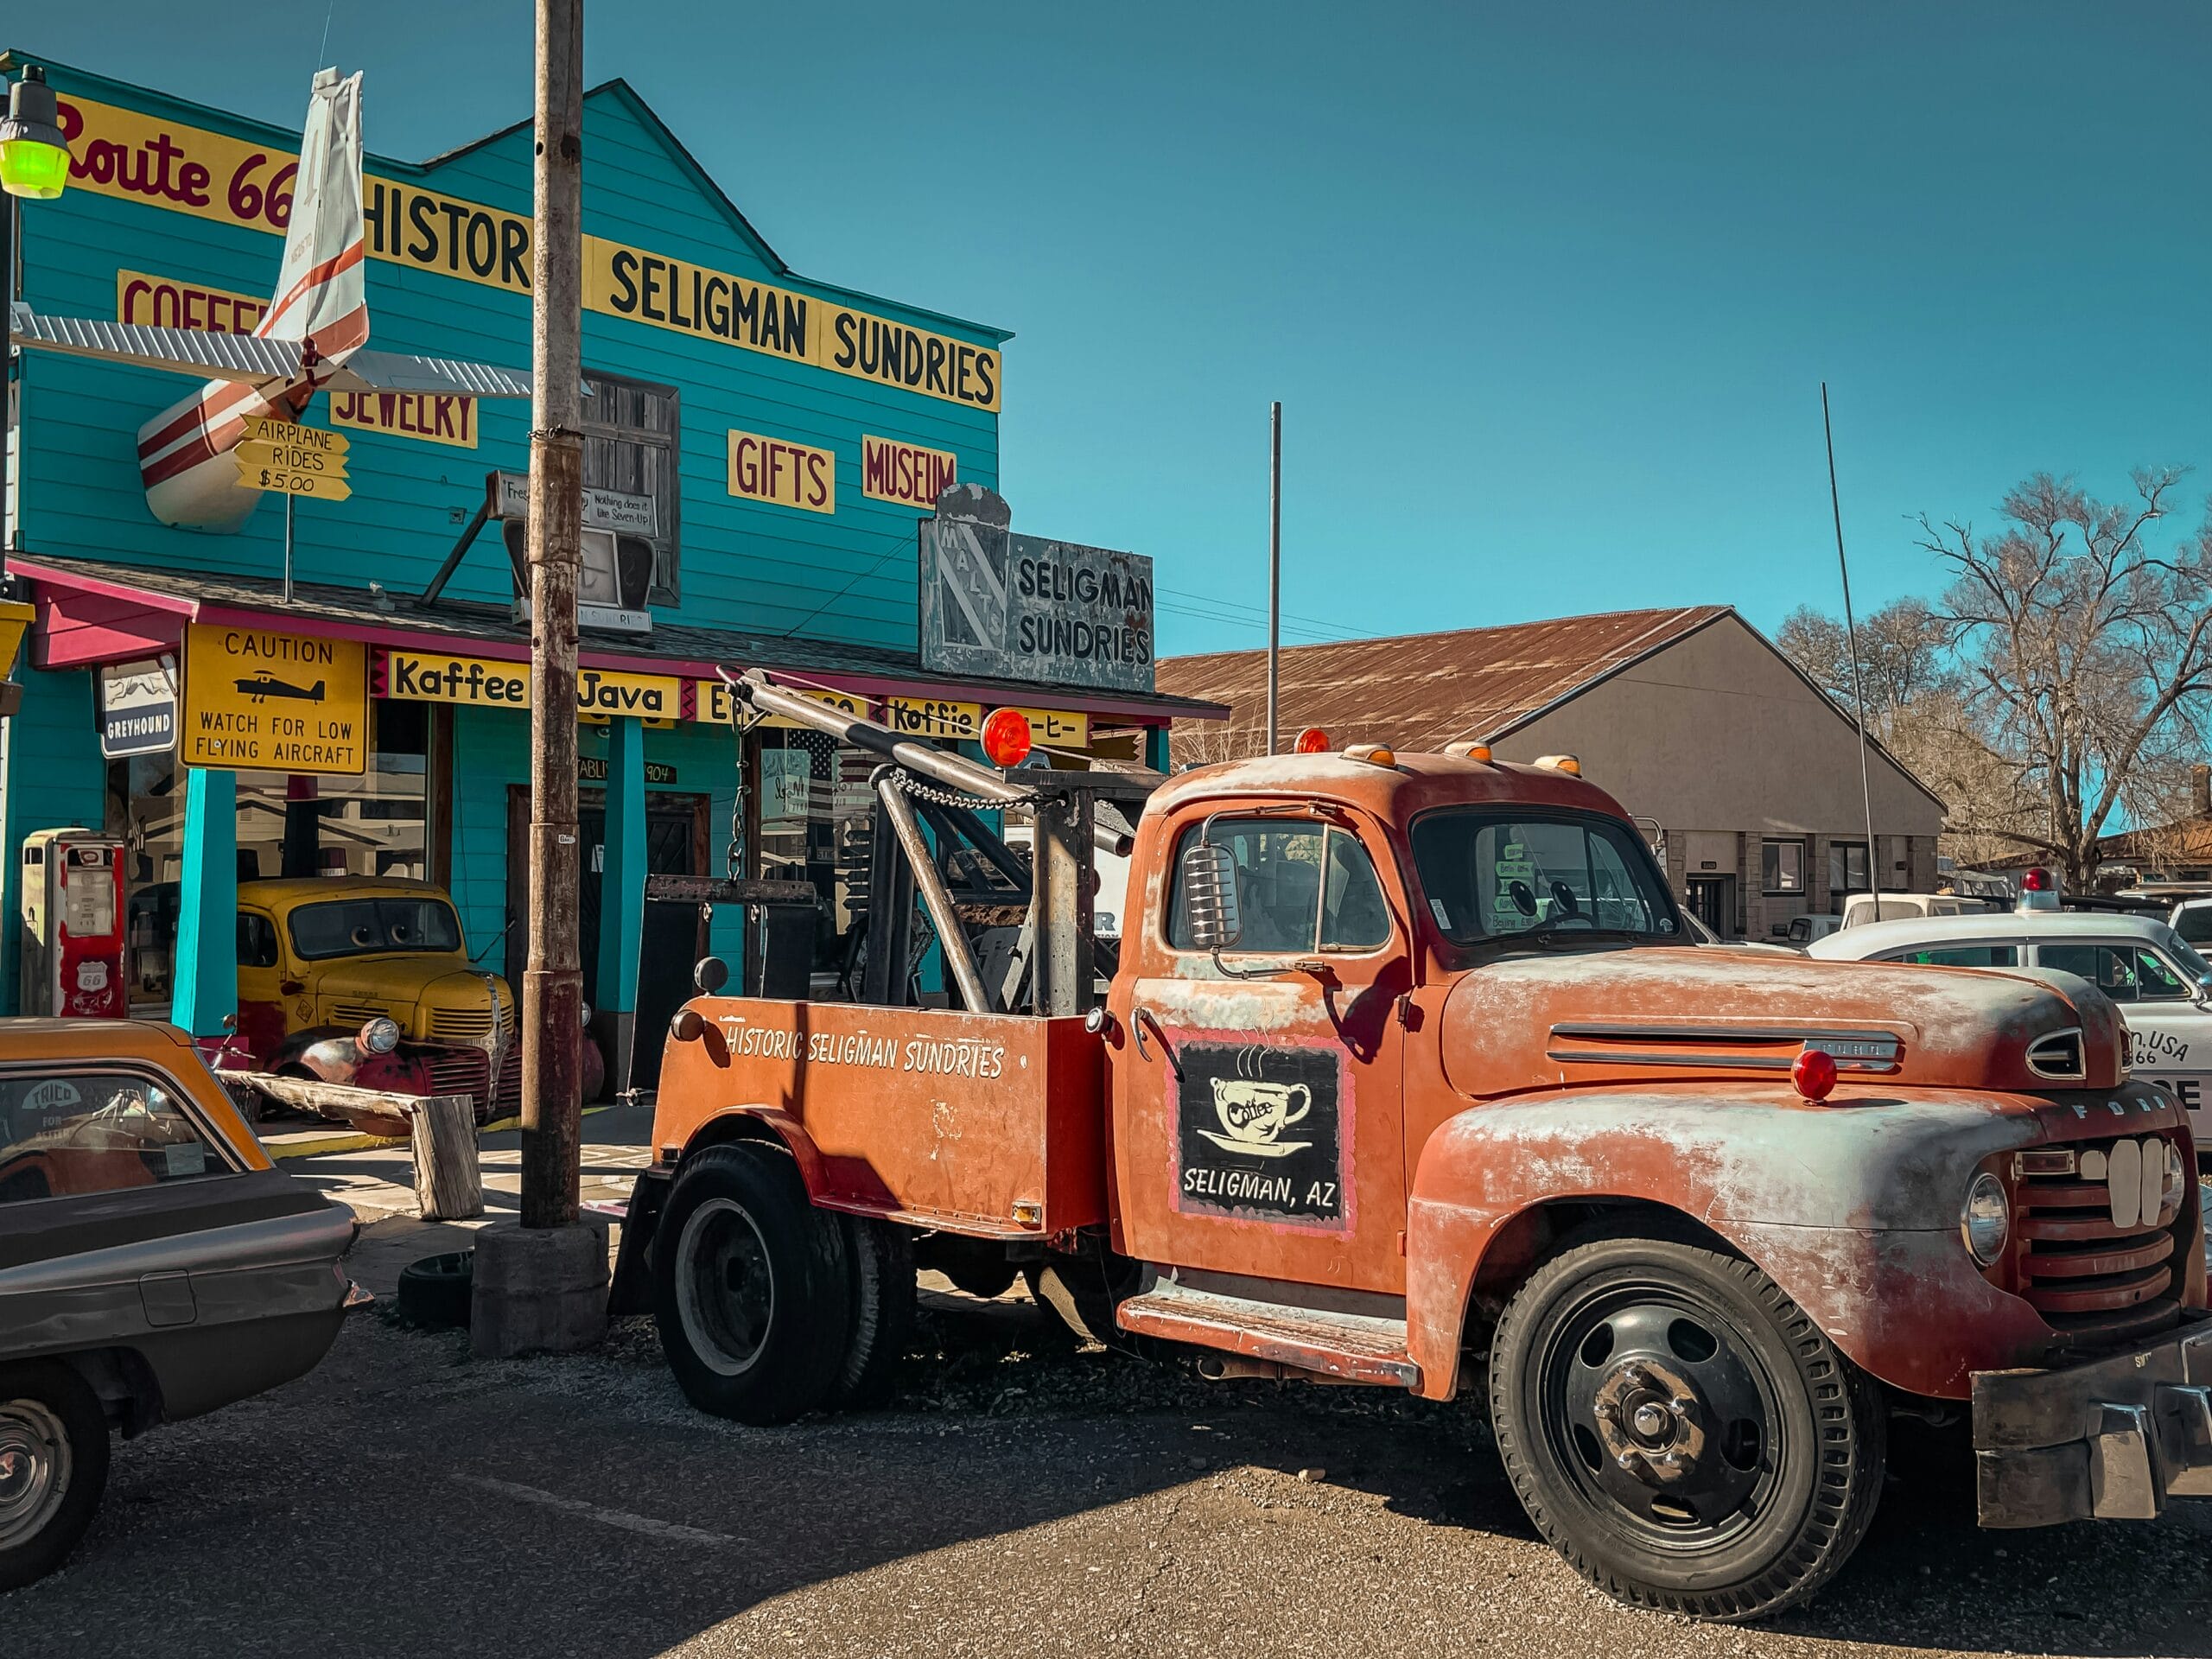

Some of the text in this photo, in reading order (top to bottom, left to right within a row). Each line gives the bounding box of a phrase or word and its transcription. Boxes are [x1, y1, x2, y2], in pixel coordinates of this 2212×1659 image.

[228, 154, 299, 228] 66
[364, 183, 995, 404] HISTOR SELIGMAN SUNDRIES
[257, 420, 334, 450] AIRPLANE
[272, 447, 324, 471] RIDES
[736, 437, 954, 506] GIFTS MUSEUM
[258, 468, 315, 492] $5.00
[594, 494, 622, 510] Nothing
[624, 499, 641, 512] does
[641, 503, 648, 512] it
[942, 524, 1002, 637] MALTS
[1020, 558, 1154, 613] SELIGMAN
[225, 632, 334, 665] CAUTION
[1020, 614, 1151, 665] SUNDRIES
[396, 658, 524, 702] Kaffee
[577, 673, 664, 711] Java
[107, 714, 170, 741] GREYHOUND
[200, 711, 352, 741] WATCH FOR LOW
[893, 701, 973, 736] Koffie
[196, 736, 354, 765] FLYING AIRCRAFT
[645, 765, 669, 782] 904
[82, 975, 101, 986] 66
[726, 1026, 1005, 1079] HISTORIC SELIGMAN SUNDRIES
[2135, 1050, 2157, 1065] 66
[33, 1083, 71, 1108] TRICO
[2071, 1095, 2166, 1119] FORD
[43, 1116, 62, 1127] FOR
[1227, 1098, 1274, 1128] Coffee
[1184, 1167, 1336, 1208] SELIGMAN, AZ
